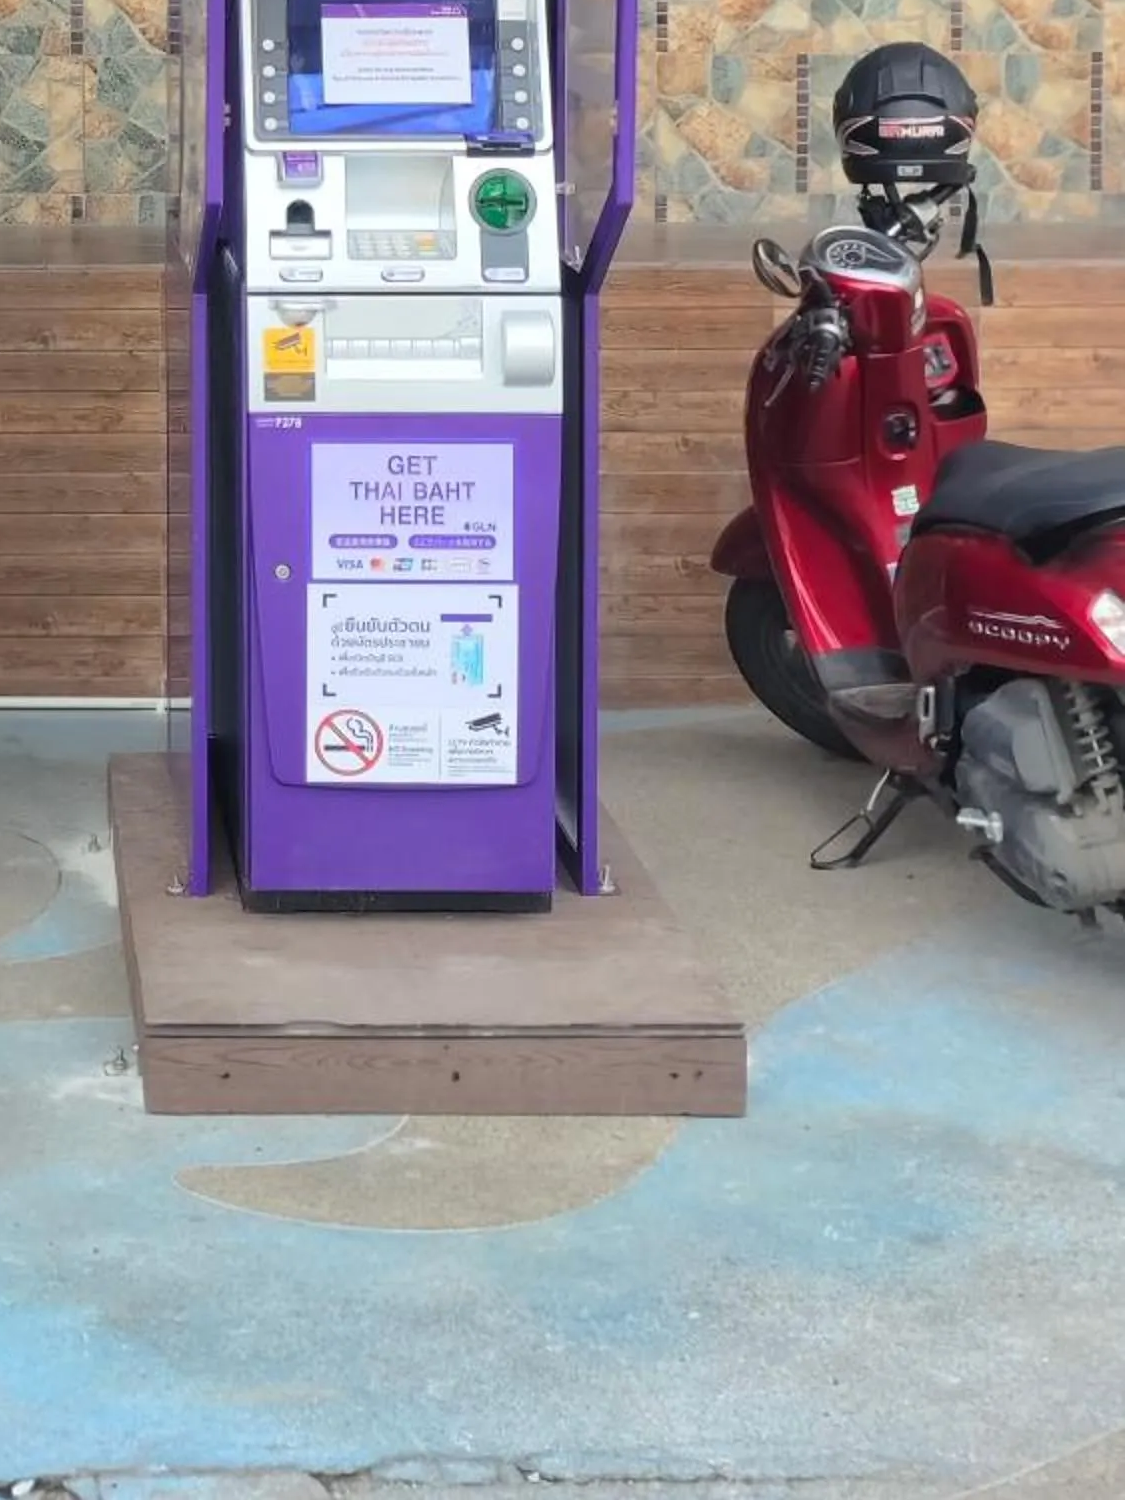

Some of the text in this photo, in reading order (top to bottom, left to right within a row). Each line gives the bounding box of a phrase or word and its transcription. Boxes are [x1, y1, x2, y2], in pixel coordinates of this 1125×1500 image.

[387, 455, 438, 476] GET
[348, 481, 476, 501] THAI BAHT
[379, 505, 446, 526] HERE
[336, 558, 364, 569] VISA
